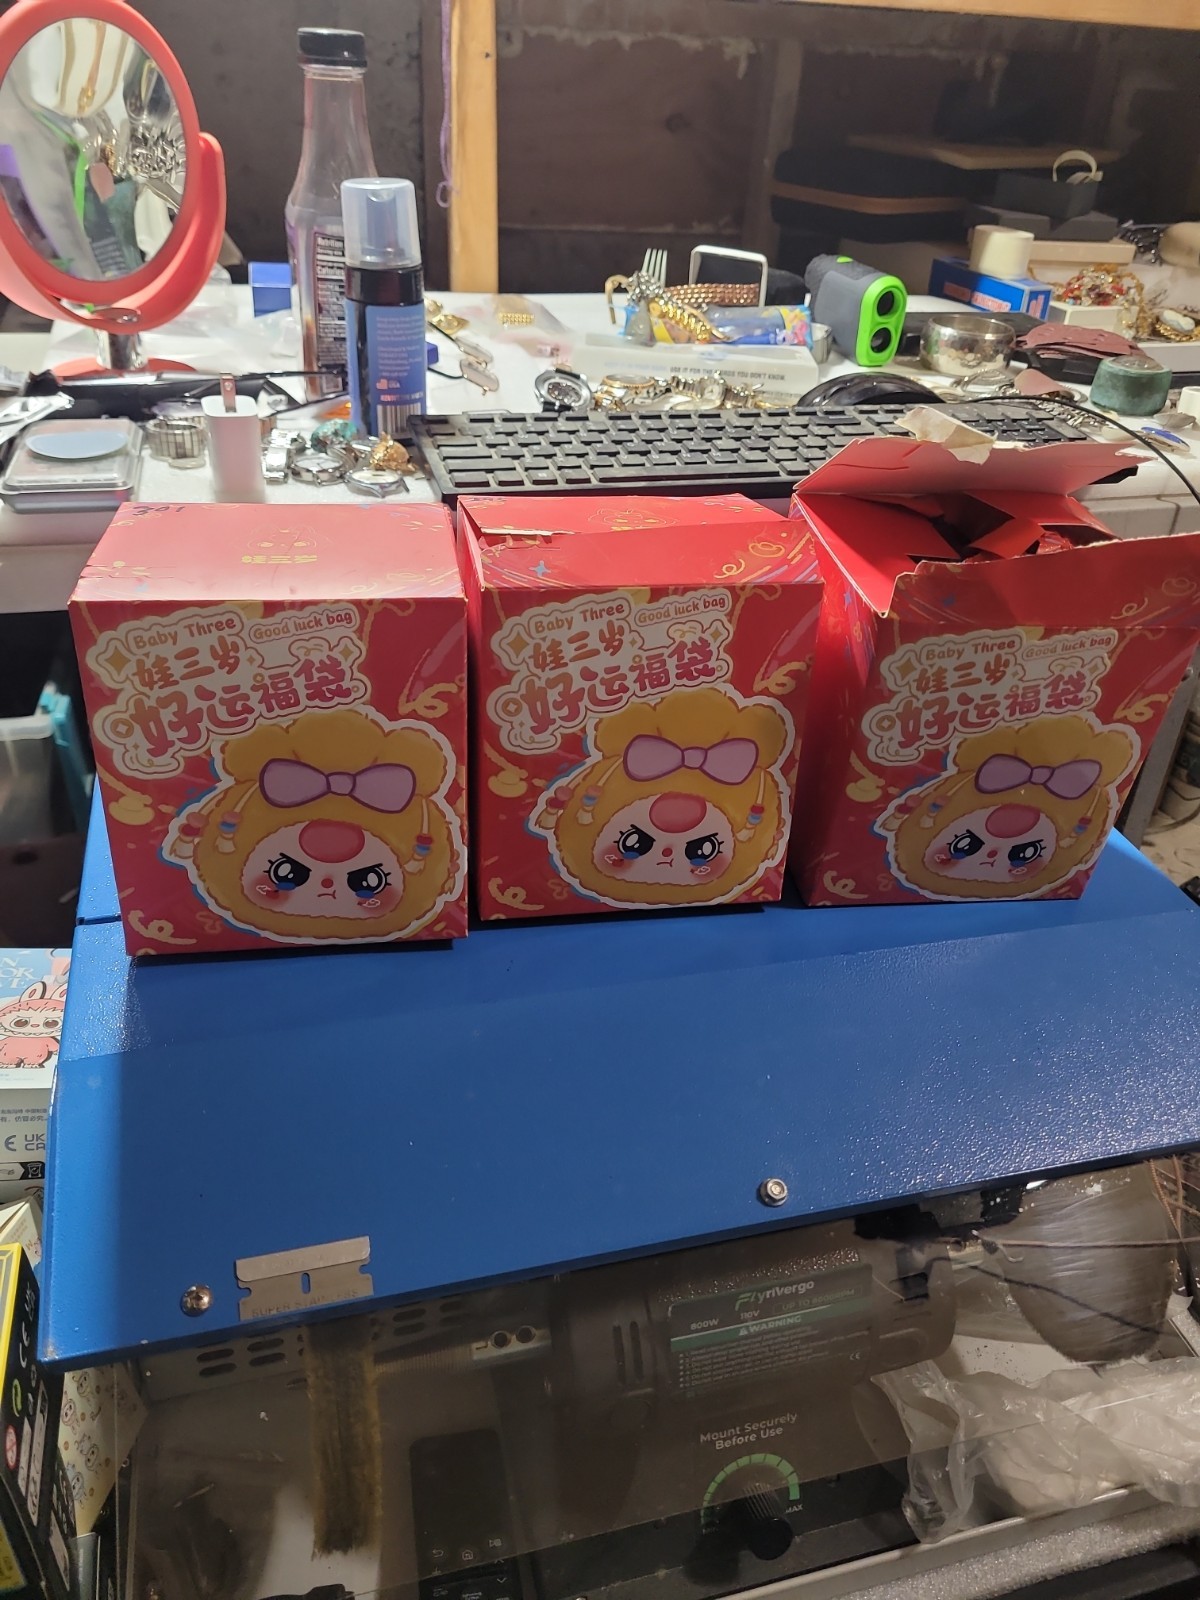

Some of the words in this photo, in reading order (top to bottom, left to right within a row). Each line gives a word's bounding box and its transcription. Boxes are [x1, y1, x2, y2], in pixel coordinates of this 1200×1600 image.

[252, 621, 292, 641] Good
[293, 615, 323, 631] luck
[326, 610, 353, 624] bag
[535, 614, 574, 634] Baby
[580, 602, 625, 623] Three
[637, 607, 671, 624] Good
[673, 600, 700, 615] luck
[702, 596, 727, 610] bag
[133, 629, 178, 650] Baby
[184, 616, 237, 638] Three
[528, 619, 625, 672] 娃三岁
[1025, 642, 1058, 658] Good
[1060, 639, 1087, 652] luck
[1089, 635, 1112, 648] bag
[133, 634, 241, 692] 娃三岁
[925, 645, 965, 662] Baby
[972, 638, 1016, 655] Three
[520, 636, 716, 735] 好运福袋
[913, 653, 1010, 695] 娃三岁
[129, 654, 352, 758] 好运福袋
[896, 670, 1087, 750] 好运福袋
[749, 1315, 802, 1333] WARNING
[700, 1426, 741, 1444] Mount
[744, 1412, 798, 1433] Securely
[715, 1433, 758, 1450] Before
[760, 1426, 784, 1439] Use
